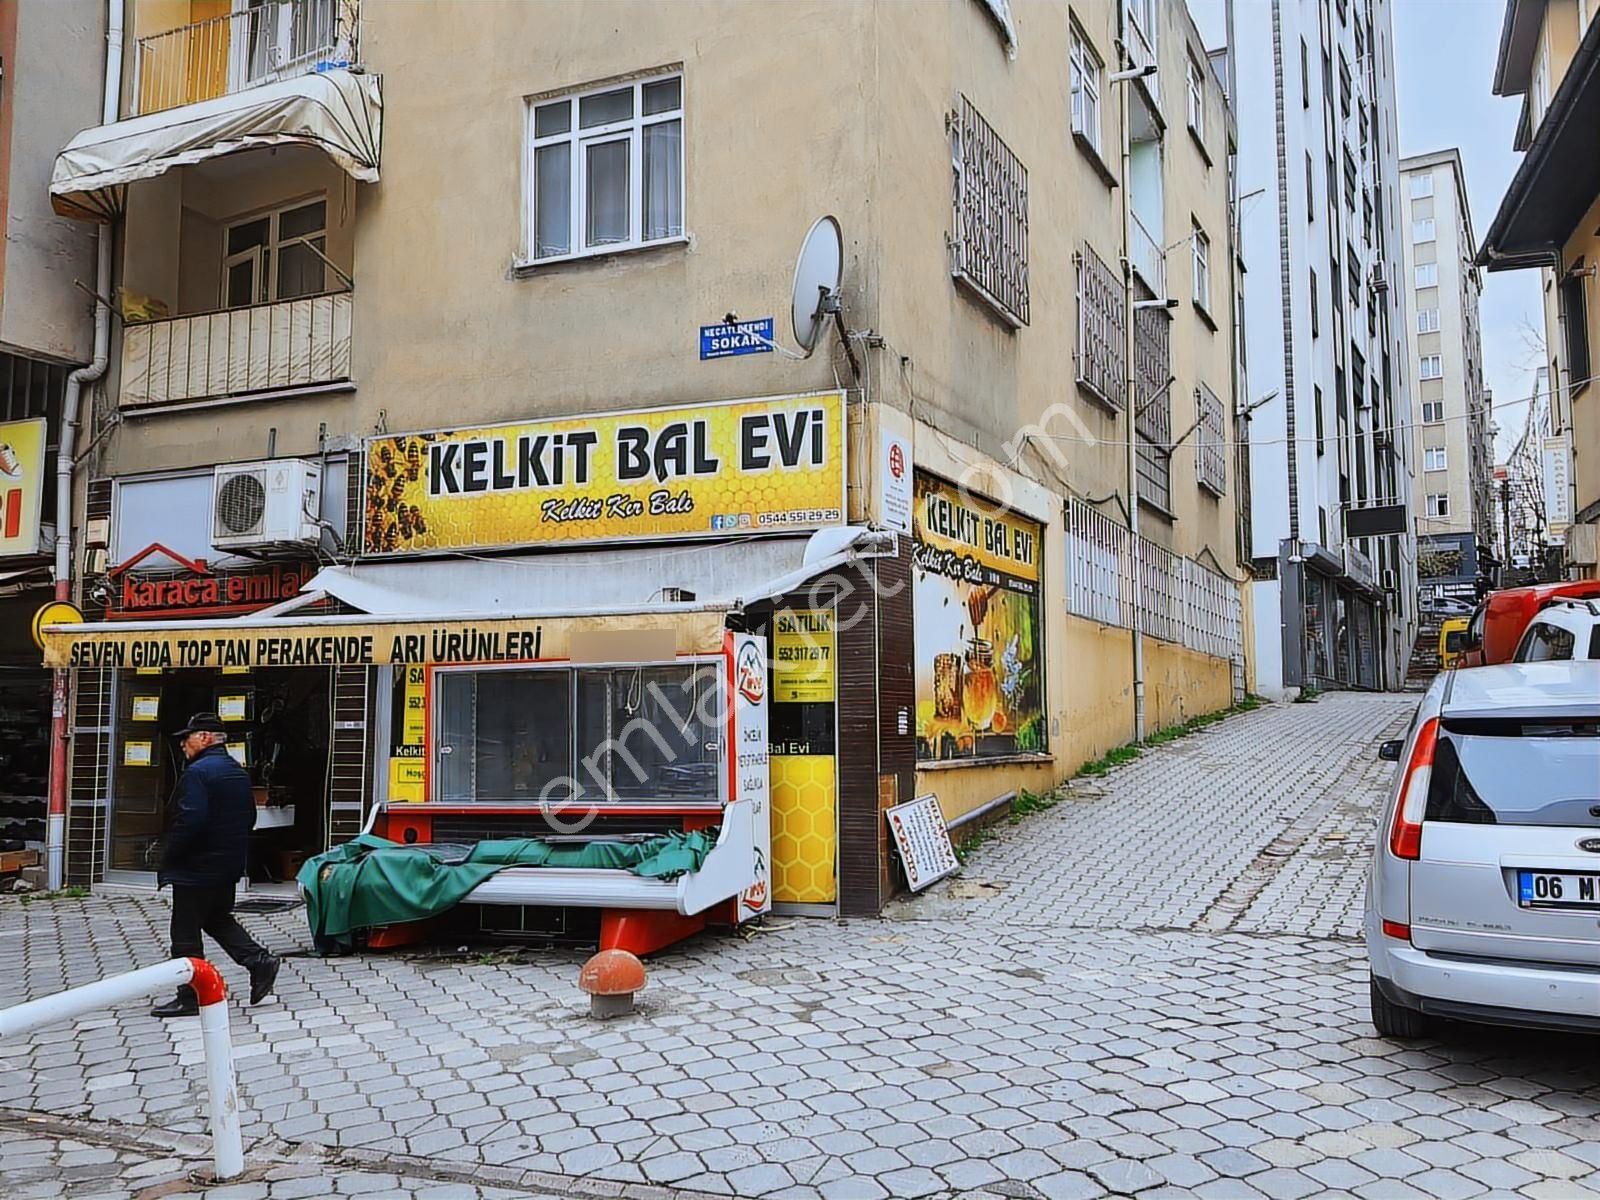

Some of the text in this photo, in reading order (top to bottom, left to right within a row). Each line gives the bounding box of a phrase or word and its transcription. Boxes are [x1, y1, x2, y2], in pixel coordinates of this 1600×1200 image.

[617, 420, 719, 483] BAL
[542, 499, 602, 522] Kelkit
[759, 513, 787, 524] 0544
[809, 511, 822, 520] 29
[825, 510, 840, 519] 29
[985, 517, 1010, 557] BAL
[124, 574, 218, 608] karaca
[778, 614, 830, 632] SATILIK
[70, 641, 125, 668] SEVEN
[131, 640, 172, 666] GIDA
[256, 636, 373, 665] PERAKENDE
[390, 635, 425, 663] ARI
[432, 626, 541, 661] ÜRÜNLERİ
[778, 647, 793, 661] 552
[794, 647, 808, 660] 317
[820, 647, 830, 660] 77
[409, 668, 425, 683] SA
[789, 742, 810, 754] Evi
[1535, 876, 1600, 900] 06 M
